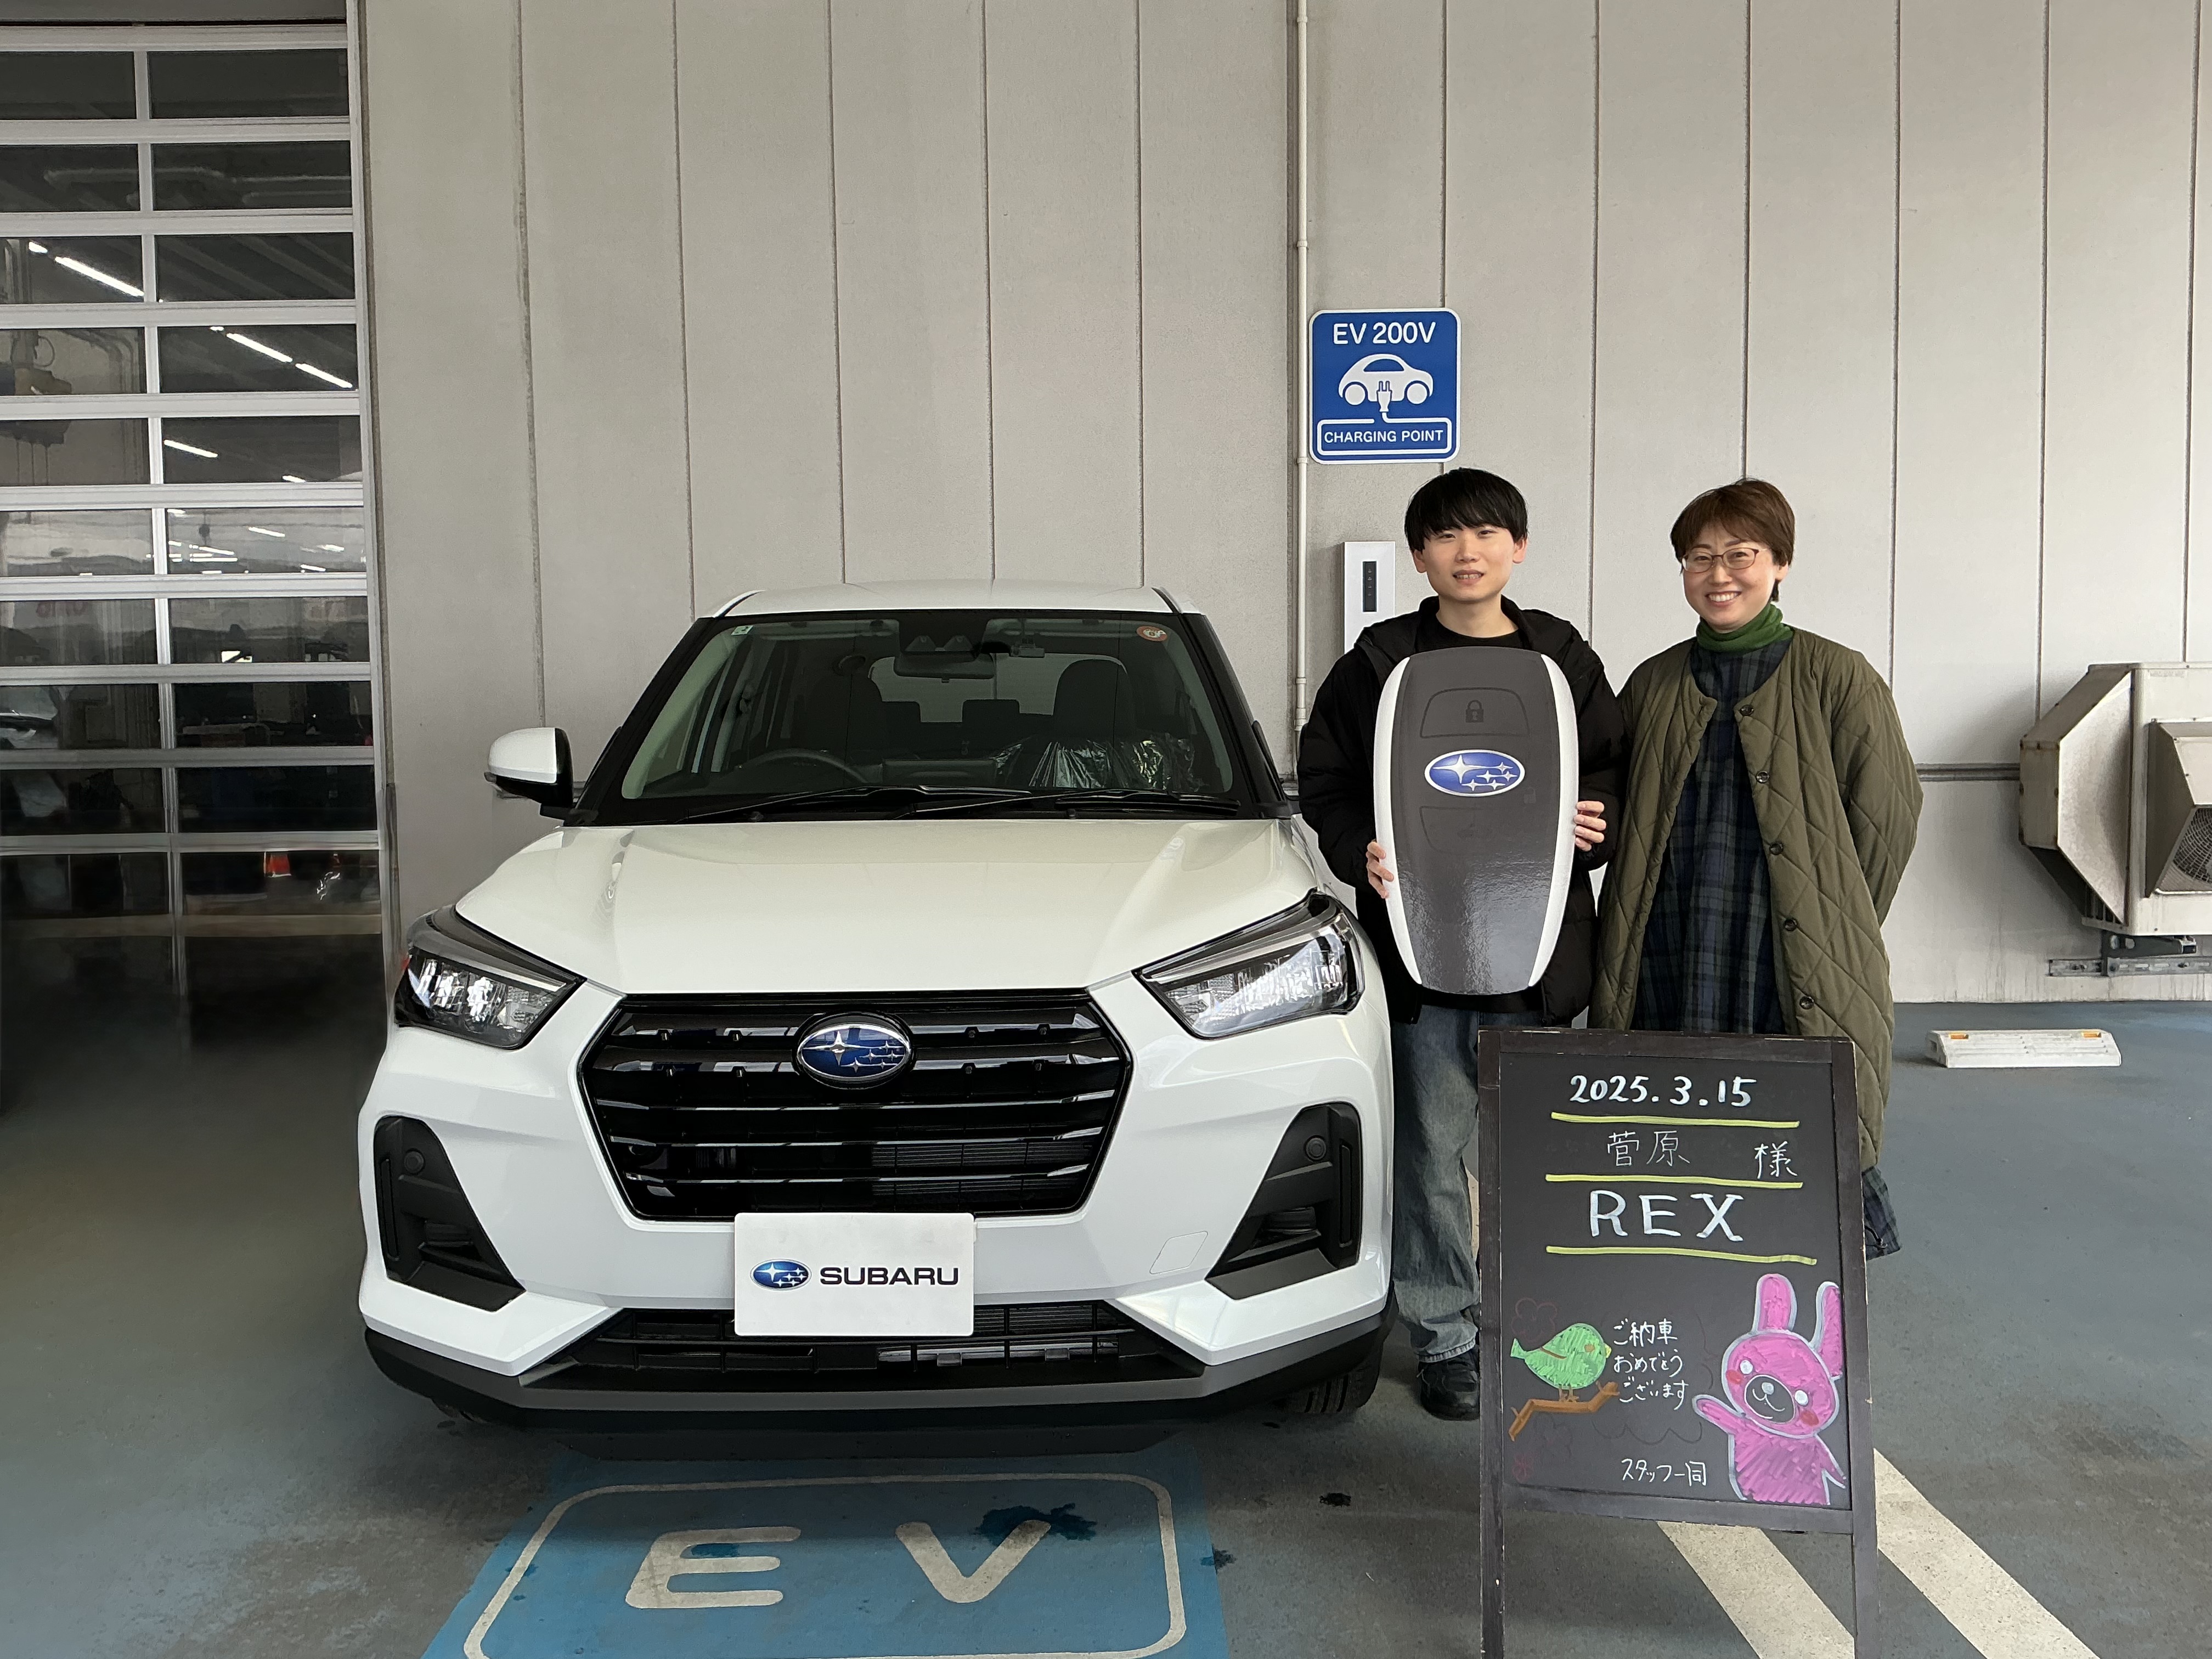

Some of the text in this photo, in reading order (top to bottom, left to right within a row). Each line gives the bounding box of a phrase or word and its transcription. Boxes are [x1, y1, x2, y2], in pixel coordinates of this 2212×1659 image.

[1333, 321, 1436, 345] EV 200V
[1324, 430, 1444, 443] CHARGING POINT
[1607, 1130, 1798, 1180] 菅原 様
[1589, 1189, 1745, 1242] REX
[820, 1267, 959, 1286] SUBARU
[1613, 1318, 1678, 1347] ご納車
[1613, 1348, 1683, 1378] おめでとう
[1618, 1375, 1689, 1410] ございます
[1621, 1458, 1707, 1487] スタッフ一同
[625, 1519, 1052, 1610] EV
